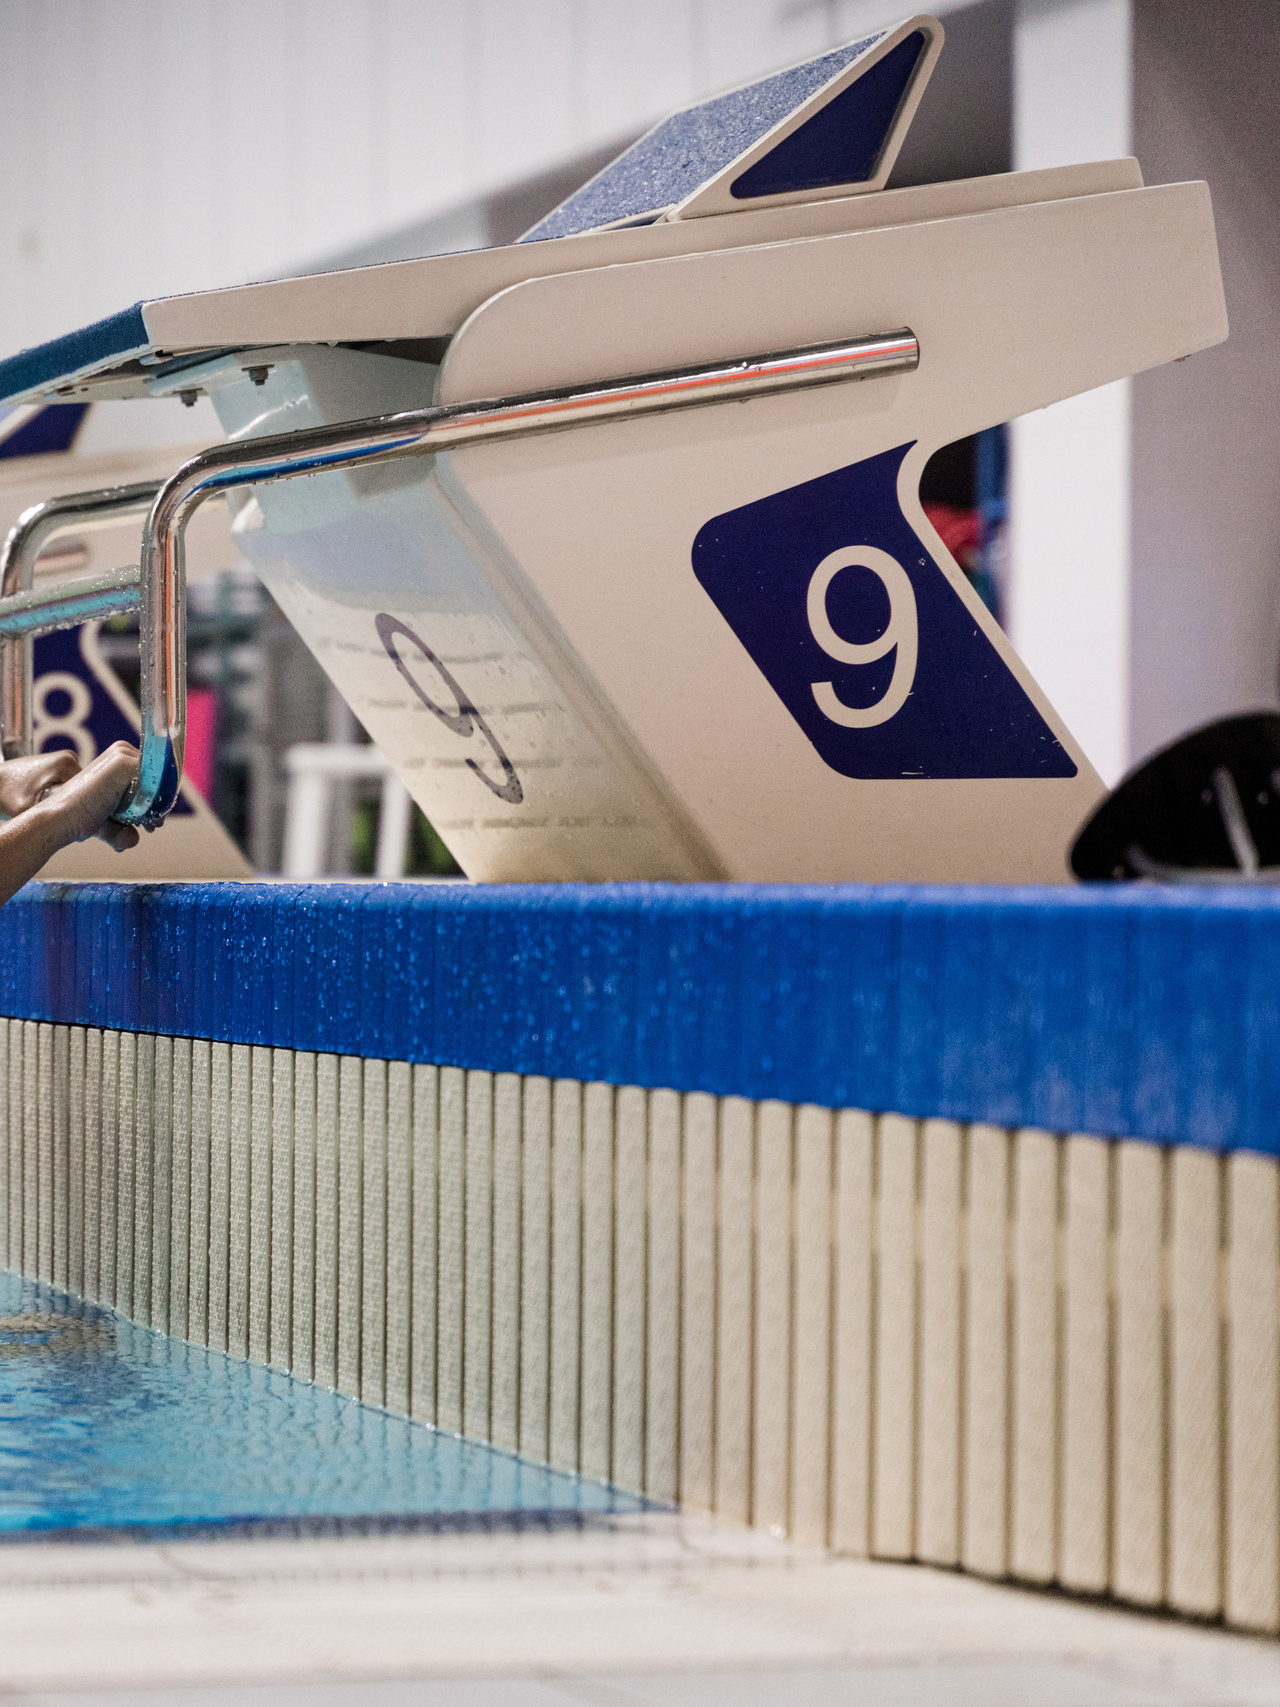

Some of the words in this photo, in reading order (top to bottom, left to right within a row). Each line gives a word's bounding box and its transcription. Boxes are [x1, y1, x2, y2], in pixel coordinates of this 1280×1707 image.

[31, 670, 99, 770] 8
[374, 612, 524, 804] 9
[806, 544, 919, 729] 9
